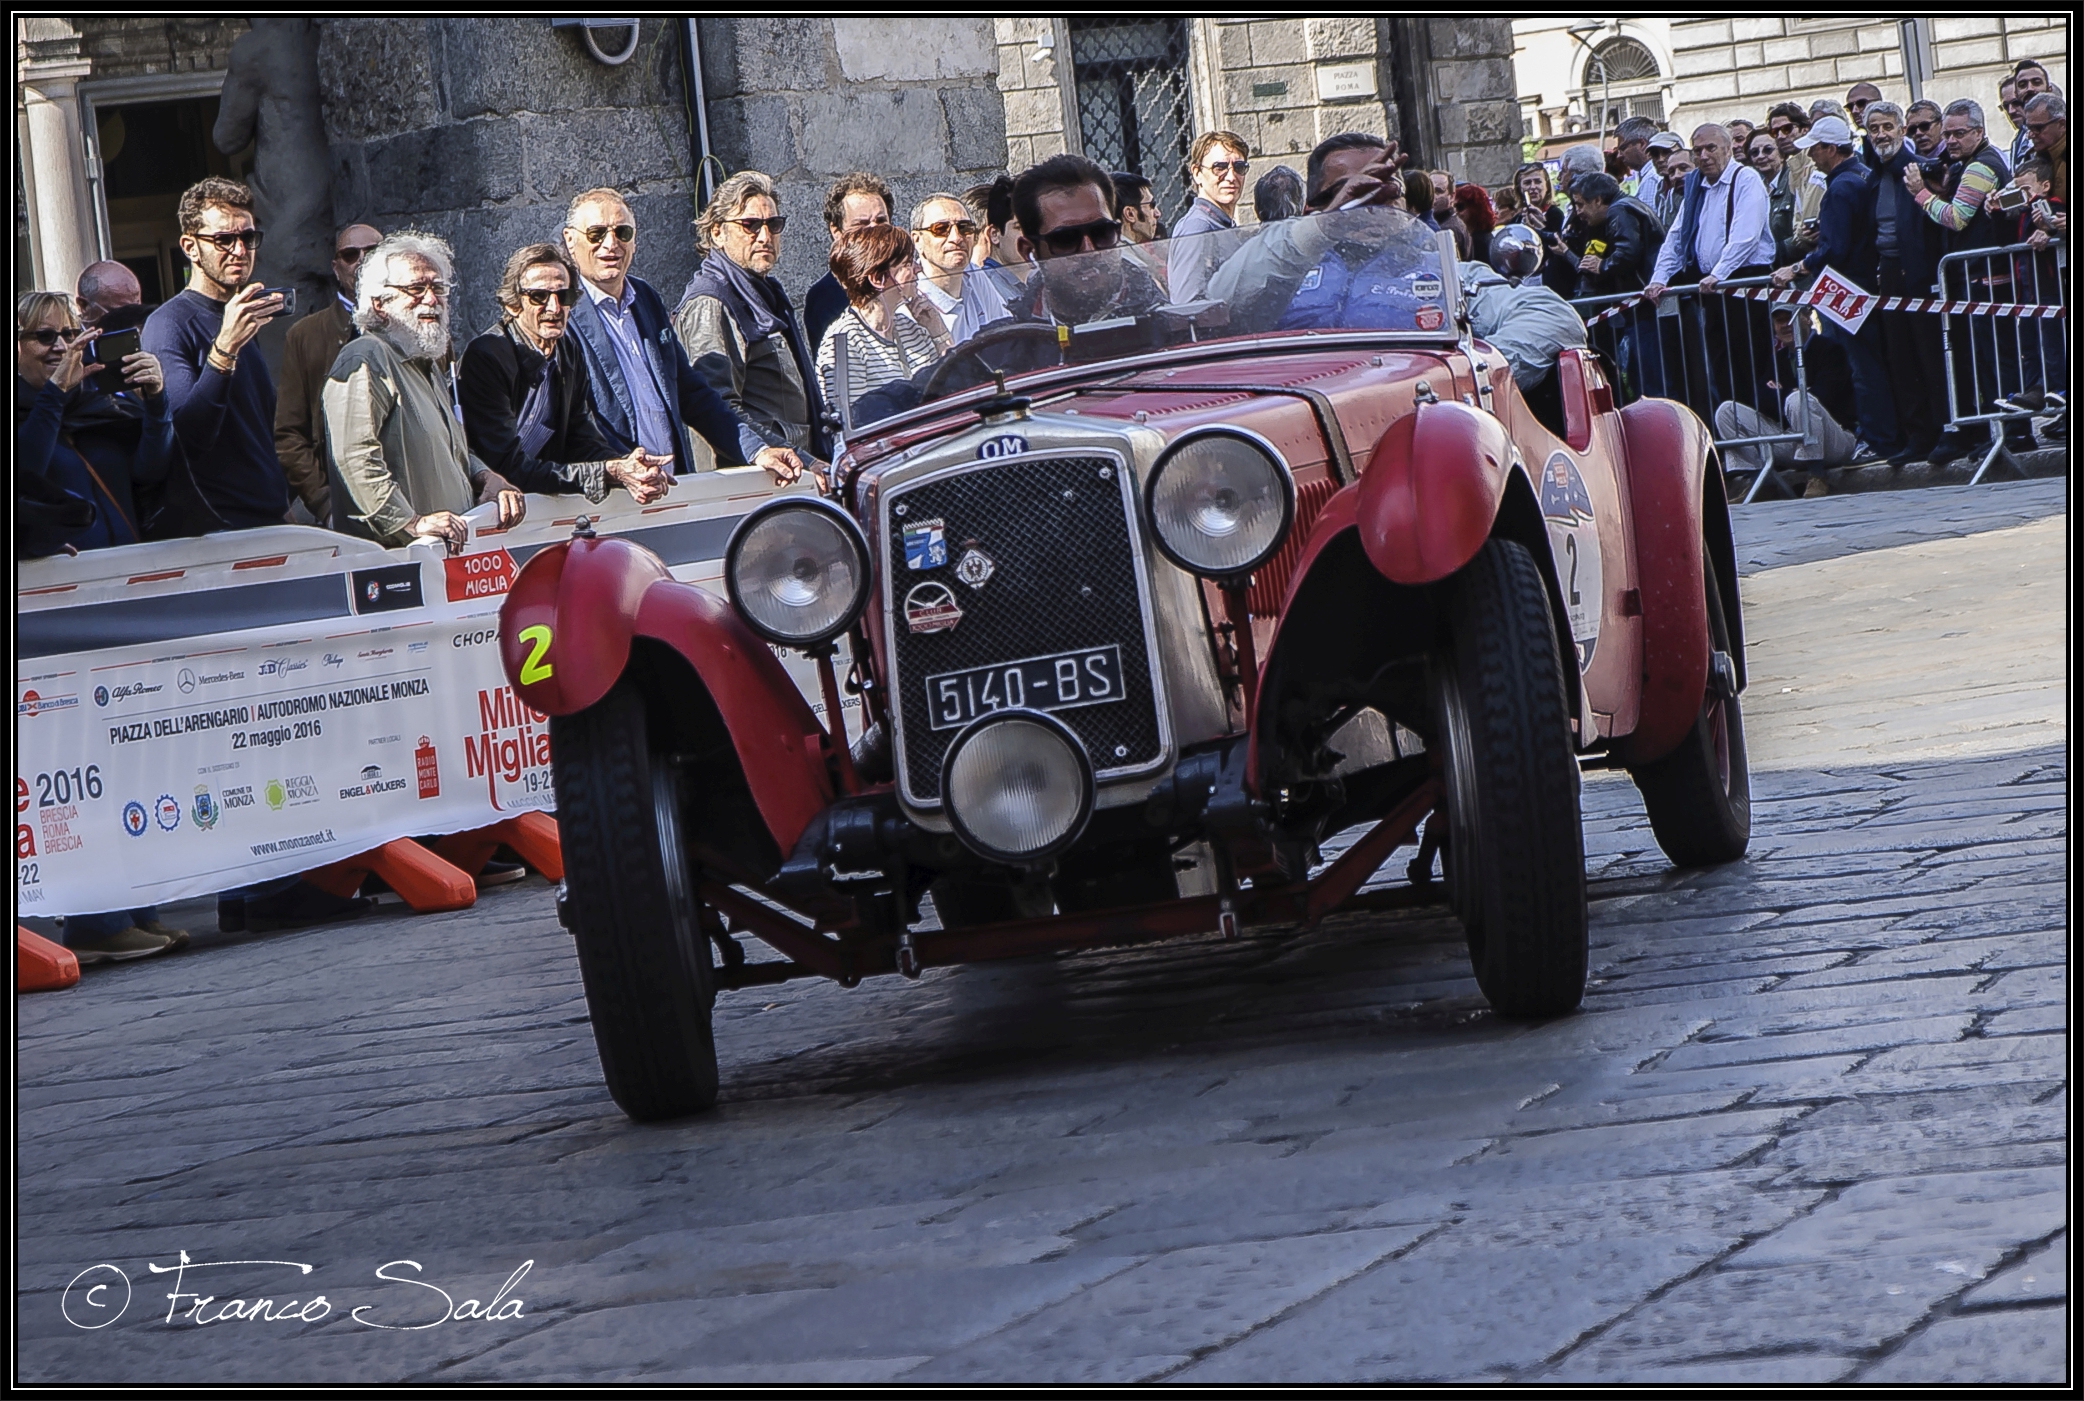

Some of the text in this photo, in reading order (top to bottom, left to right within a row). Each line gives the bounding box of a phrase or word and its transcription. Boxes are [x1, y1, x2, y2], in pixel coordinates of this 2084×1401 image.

[1333, 71, 1359, 80] PIAZZA
[1335, 83, 1360, 92] ROMA
[981, 437, 1023, 459] OM
[464, 554, 502, 574] 1000
[1566, 533, 1581, 606] 2
[465, 576, 508, 596] MIGLIA
[919, 607, 942, 617] CLUB
[518, 624, 554, 686] 2
[277, 657, 308, 679] Classics
[199, 670, 245, 686] Mercedes-Benz
[112, 682, 163, 702] Alfa Romeo
[938, 654, 1112, 722] 5140-BS
[110, 678, 430, 745] PIAZZA DELL'ARENGARIO AUTODROMO NAZIONALE MONZA
[232, 721, 321, 750] 22 maggio 2016
[417, 755, 436, 768] RADIO
[418, 766, 437, 779] MONTE
[523, 769, 555, 793] 19-2
[36, 763, 103, 808] 2016
[222, 785, 253, 798] COMUNE DI
[285, 775, 316, 790] REGGIA
[420, 777, 438, 791] CARLO
[223, 794, 256, 810] MONZA
[287, 785, 319, 801] MONZA
[40, 805, 79, 824] BRESCIA
[42, 822, 71, 839] ROMA
[44, 835, 83, 854] BRESCIA
[250, 829, 337, 856] www.monzanet.it
